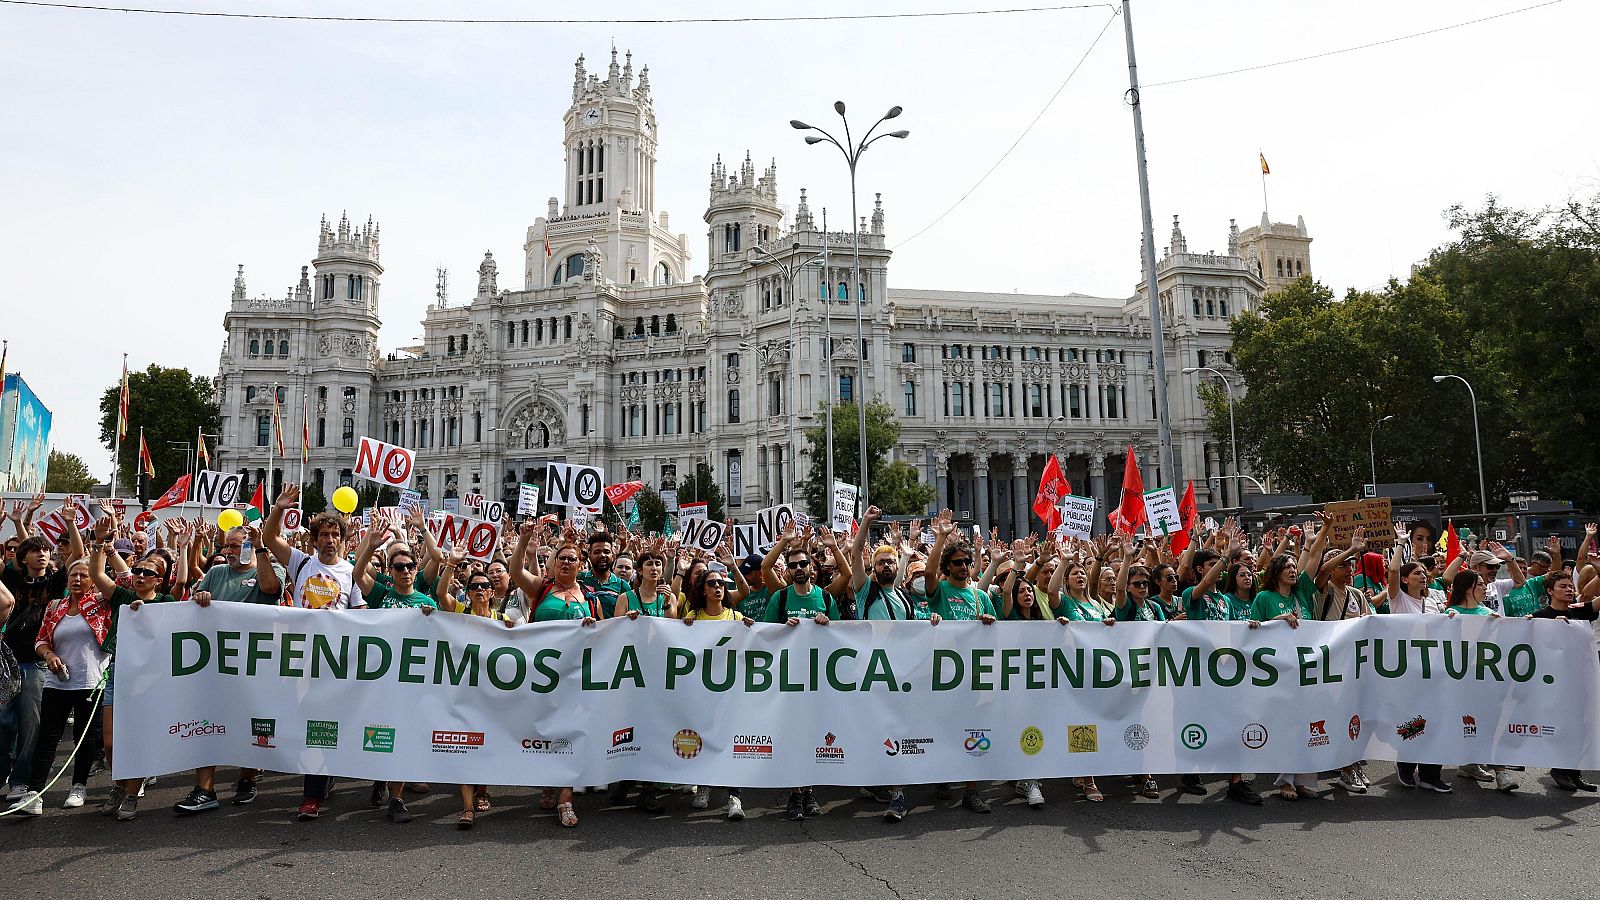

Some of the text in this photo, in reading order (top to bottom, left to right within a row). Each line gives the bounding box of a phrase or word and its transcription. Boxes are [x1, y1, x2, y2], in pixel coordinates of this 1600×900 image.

[355, 439, 411, 484] NO
[197, 472, 239, 506] NO
[548, 464, 602, 505] NO
[464, 494, 483, 507] NO
[1072, 501, 1092, 512] ESCUELAS
[481, 502, 502, 522] NO
[1067, 510, 1091, 522] PÚBLICAS
[758, 506, 793, 546] NO
[437, 514, 497, 557] NO
[682, 517, 720, 550] NO
[87, 607, 98, 616] CGT
[171, 631, 1554, 693] DEFENDEMOS LA PÚBLICA. DEFENDEMOS EL FUTURO.
[1508, 724, 1528, 734] UGT
[434, 733, 468, 742] CCOO
[615, 731, 630, 742] CNT
[733, 734, 773, 744] CONFAPA
[521, 739, 552, 749] CGT
